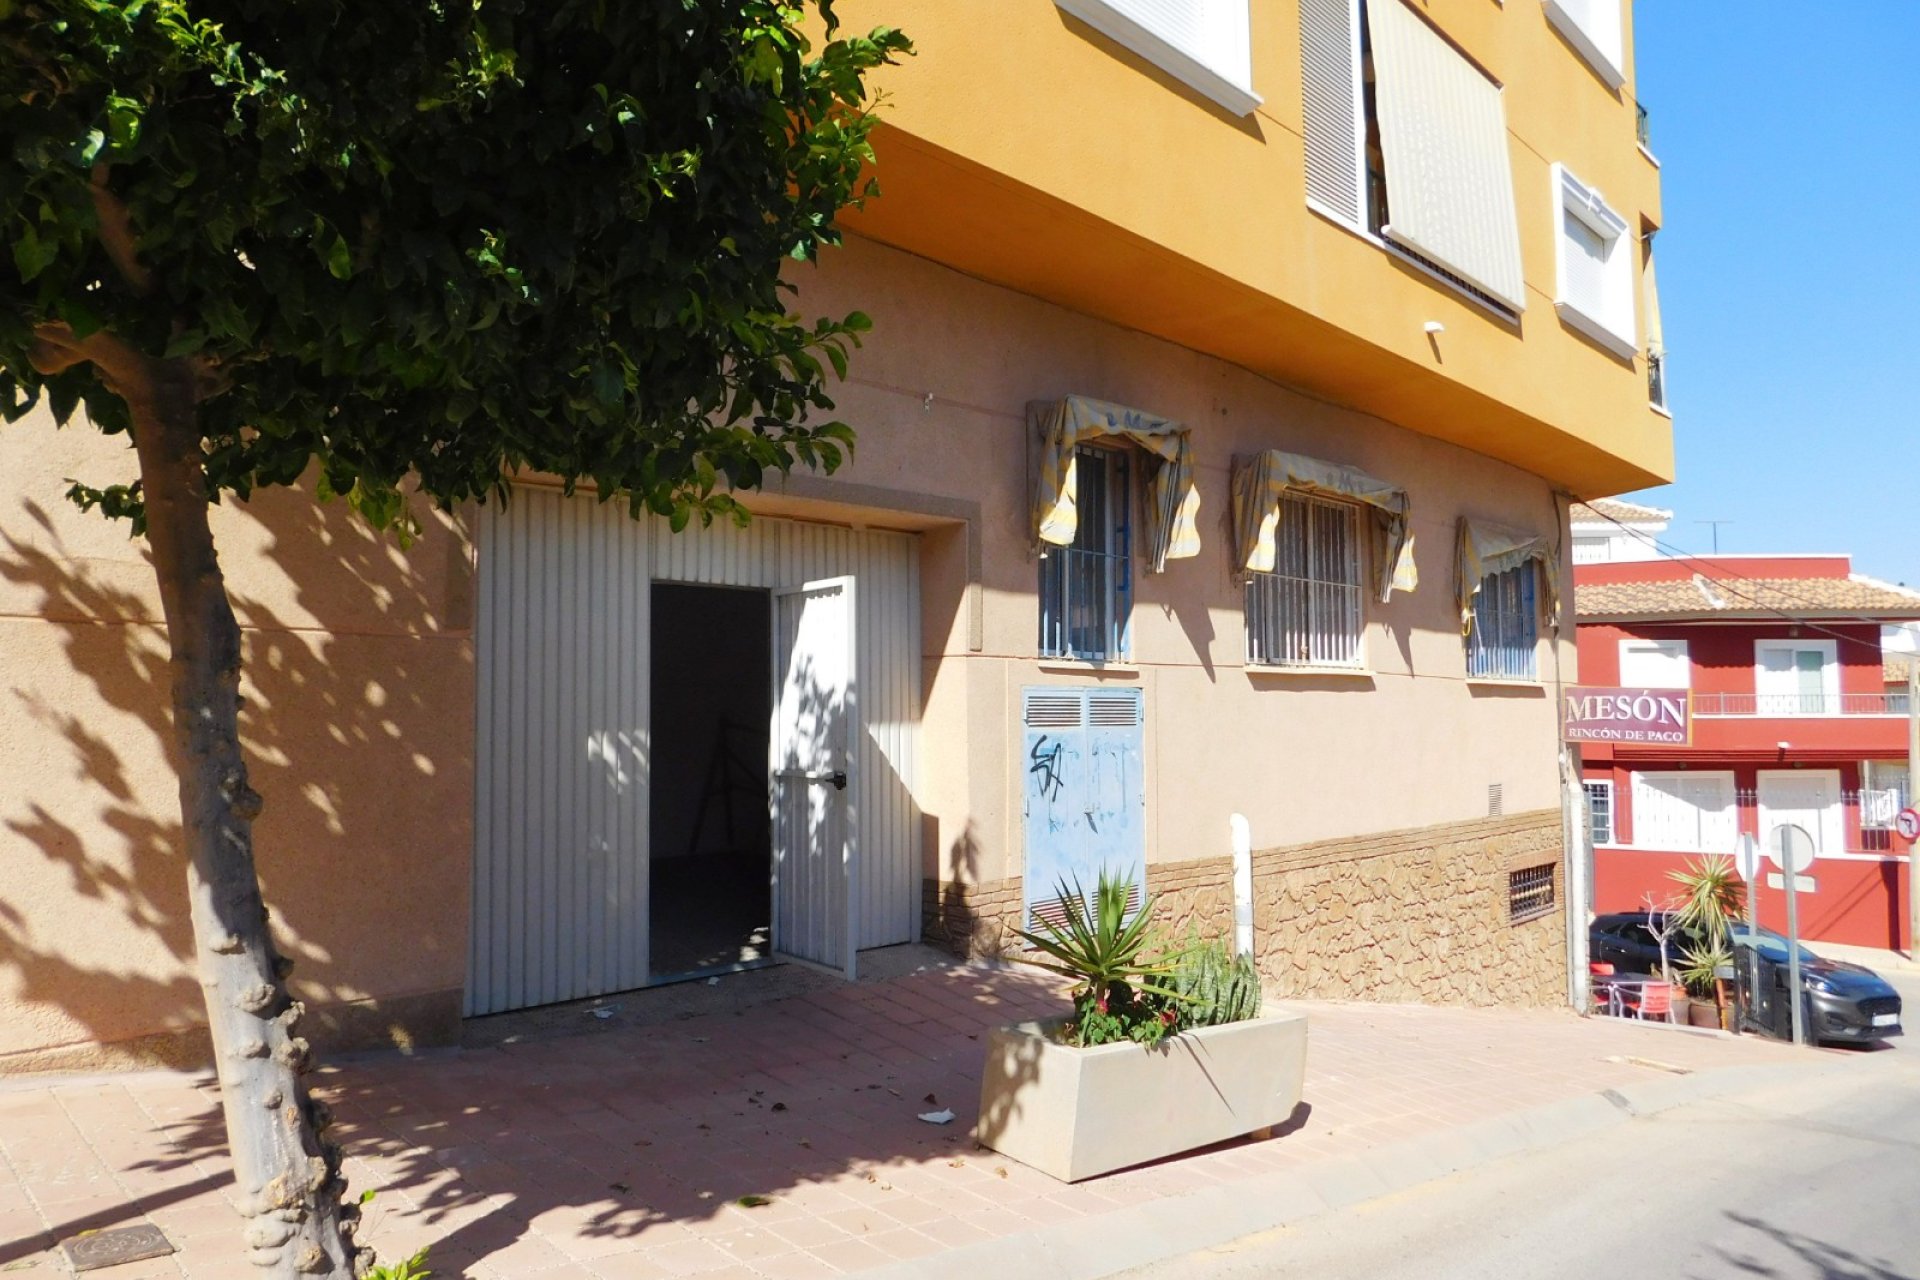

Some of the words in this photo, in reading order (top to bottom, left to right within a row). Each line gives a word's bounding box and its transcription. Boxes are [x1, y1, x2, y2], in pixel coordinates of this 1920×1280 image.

[1565, 690, 1686, 728] MESÓN
[1569, 727, 1621, 739] RINCÓN
[1625, 730, 1644, 741] DE
[1648, 731, 1683, 742] PACO
